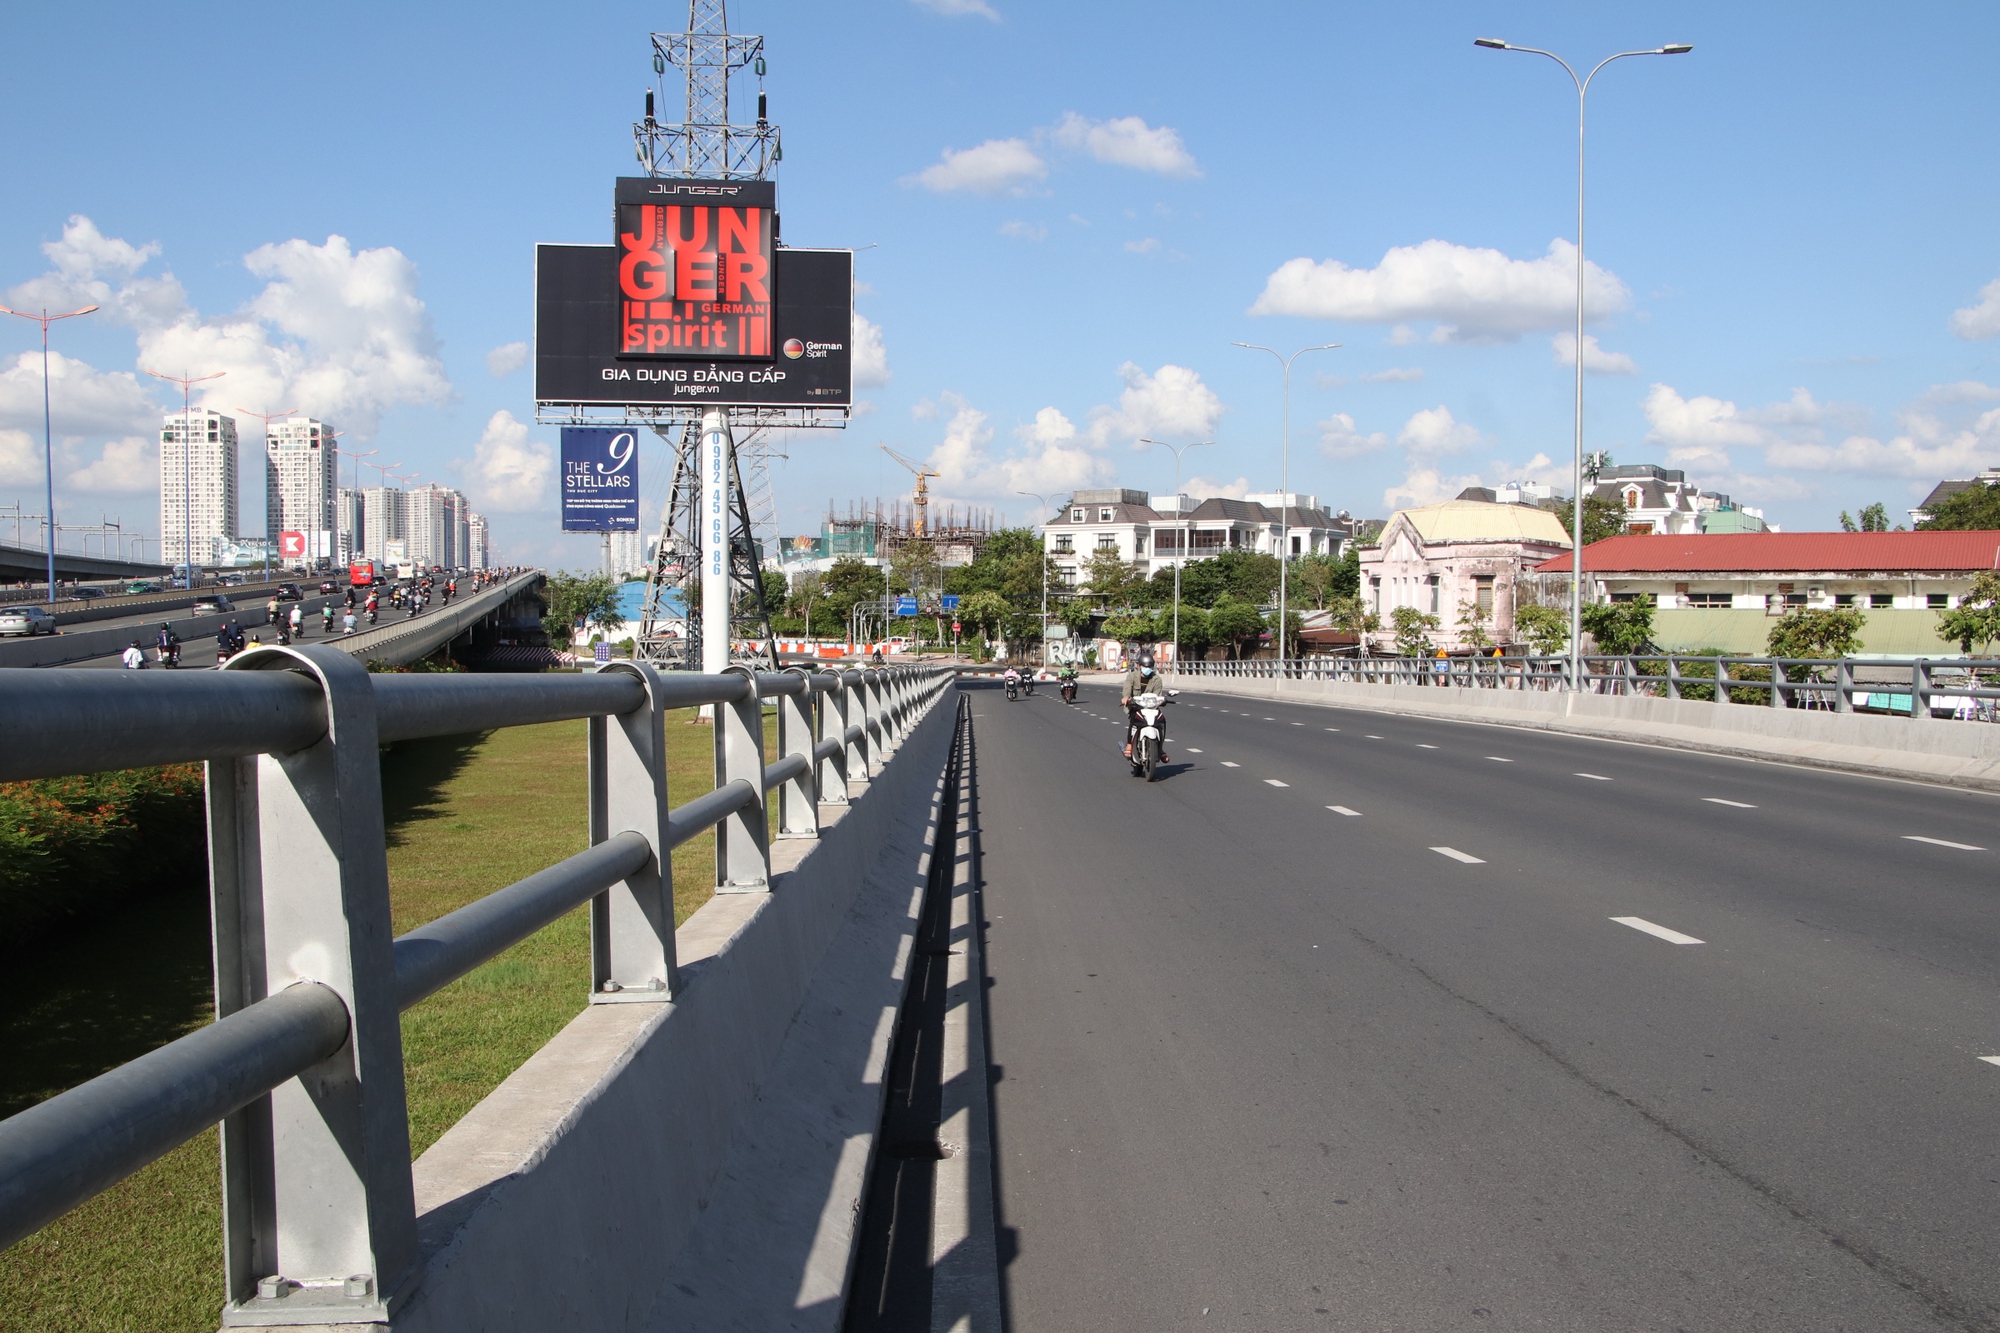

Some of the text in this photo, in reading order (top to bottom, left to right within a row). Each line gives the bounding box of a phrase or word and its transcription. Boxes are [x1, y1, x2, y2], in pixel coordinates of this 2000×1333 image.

[648, 184, 738, 196] JUNGER
[656, 206, 664, 249] GERMAN
[701, 303, 765, 314] GERMAN
[626, 315, 727, 353] spirit
[806, 341, 843, 350] German
[806, 349, 827, 359] Spirit
[602, 368, 631, 381] GIA
[636, 369, 687, 384] DỤNG
[749, 366, 786, 383] CẤP
[673, 383, 720, 396] junger.vn
[566, 432, 635, 474] THE 9
[566, 475, 630, 488] STELLARS
